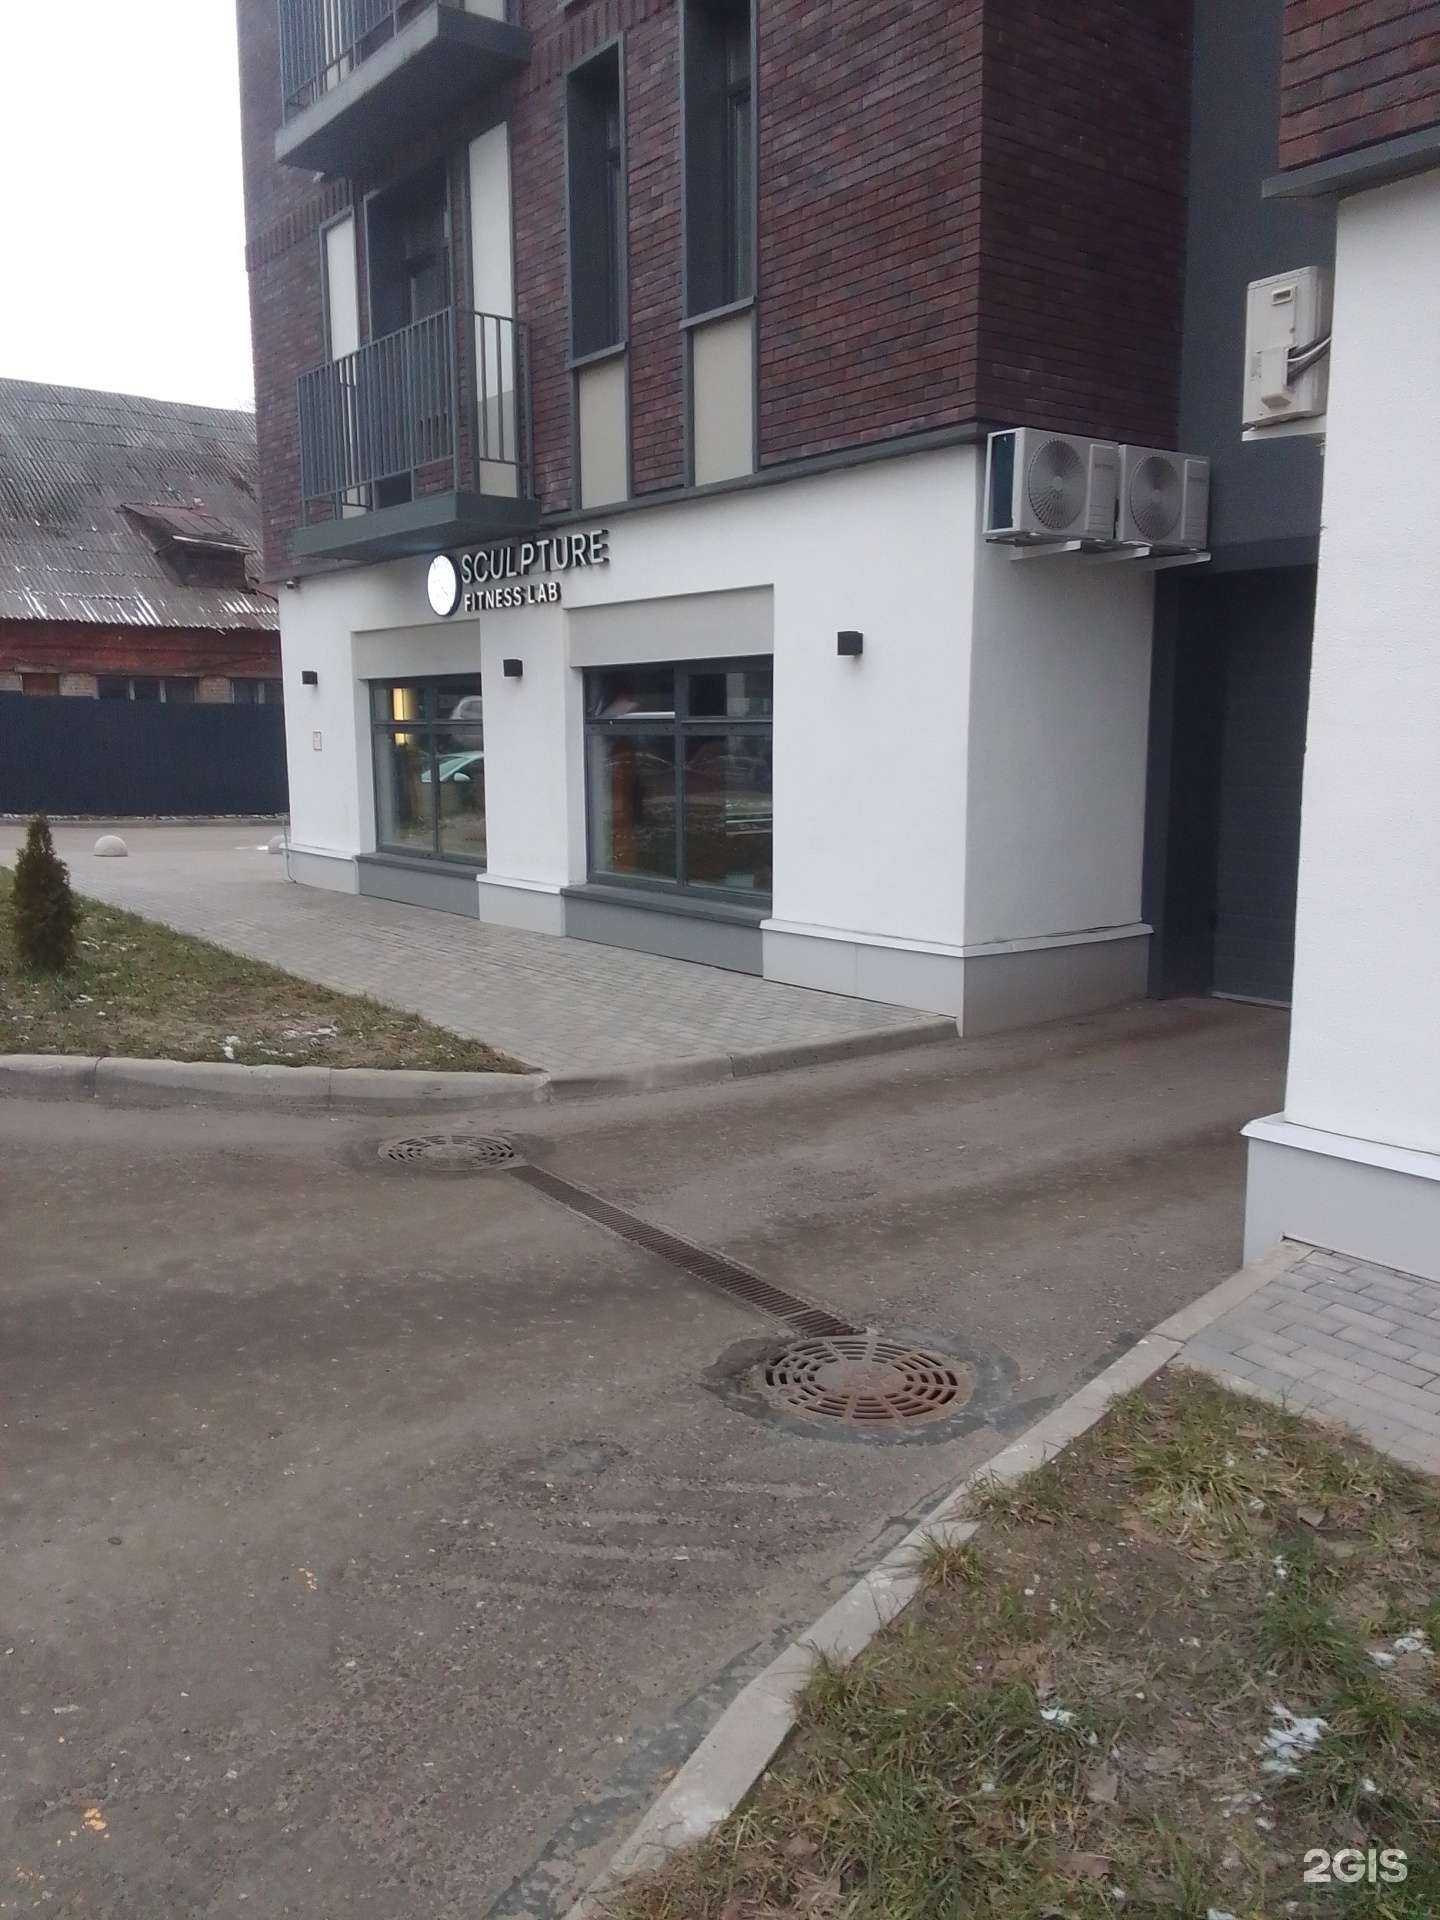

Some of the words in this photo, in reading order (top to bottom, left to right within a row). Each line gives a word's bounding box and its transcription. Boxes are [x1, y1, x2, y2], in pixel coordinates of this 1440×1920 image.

[461, 529, 608, 584] SCULPTURE
[463, 586, 523, 612] FITNESS
[526, 581, 561, 604] LAB
